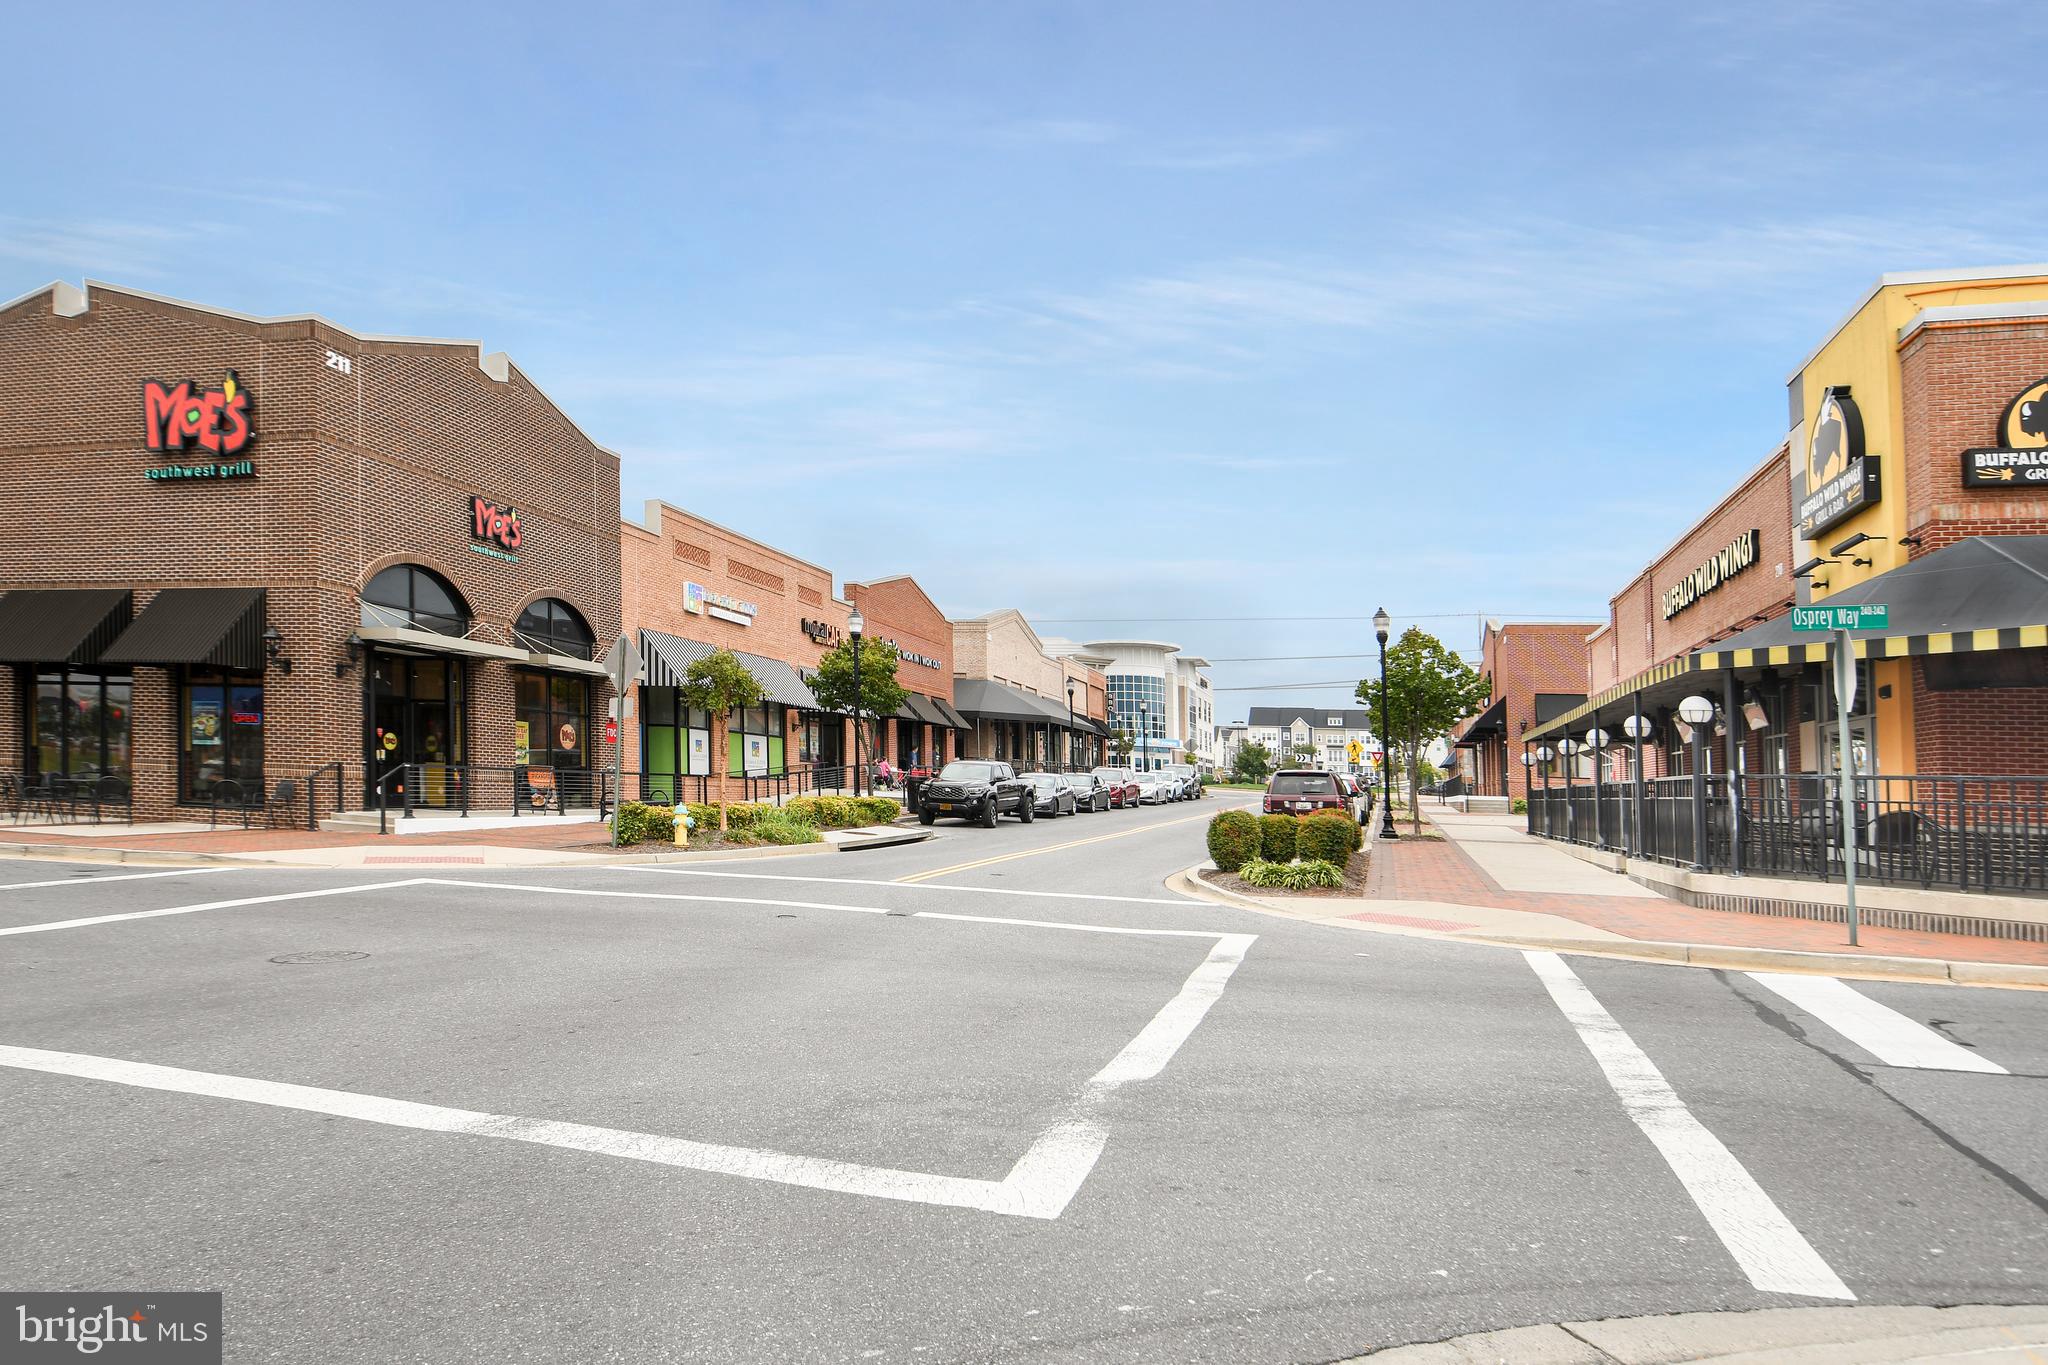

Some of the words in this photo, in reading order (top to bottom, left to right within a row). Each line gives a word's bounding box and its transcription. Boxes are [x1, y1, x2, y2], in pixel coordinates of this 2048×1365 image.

[325, 350, 351, 375] 211
[144, 463, 216, 480] southwest
[220, 460, 251, 477] grill
[1974, 451, 2048, 467] BUFFALO
[1800, 492, 1823, 520] BUFFALO
[1823, 481, 1839, 503] WILD
[1839, 465, 1861, 493] WINGS
[1815, 507, 1829, 525] GRILL
[1833, 496, 1845, 514] BAR
[1662, 574, 1695, 620] BUFFALO
[1694, 556, 1719, 598] WILD
[1718, 529, 1755, 581] WINGS
[1793, 608, 1833, 629] Osprey
[1837, 608, 1859, 629] Way
